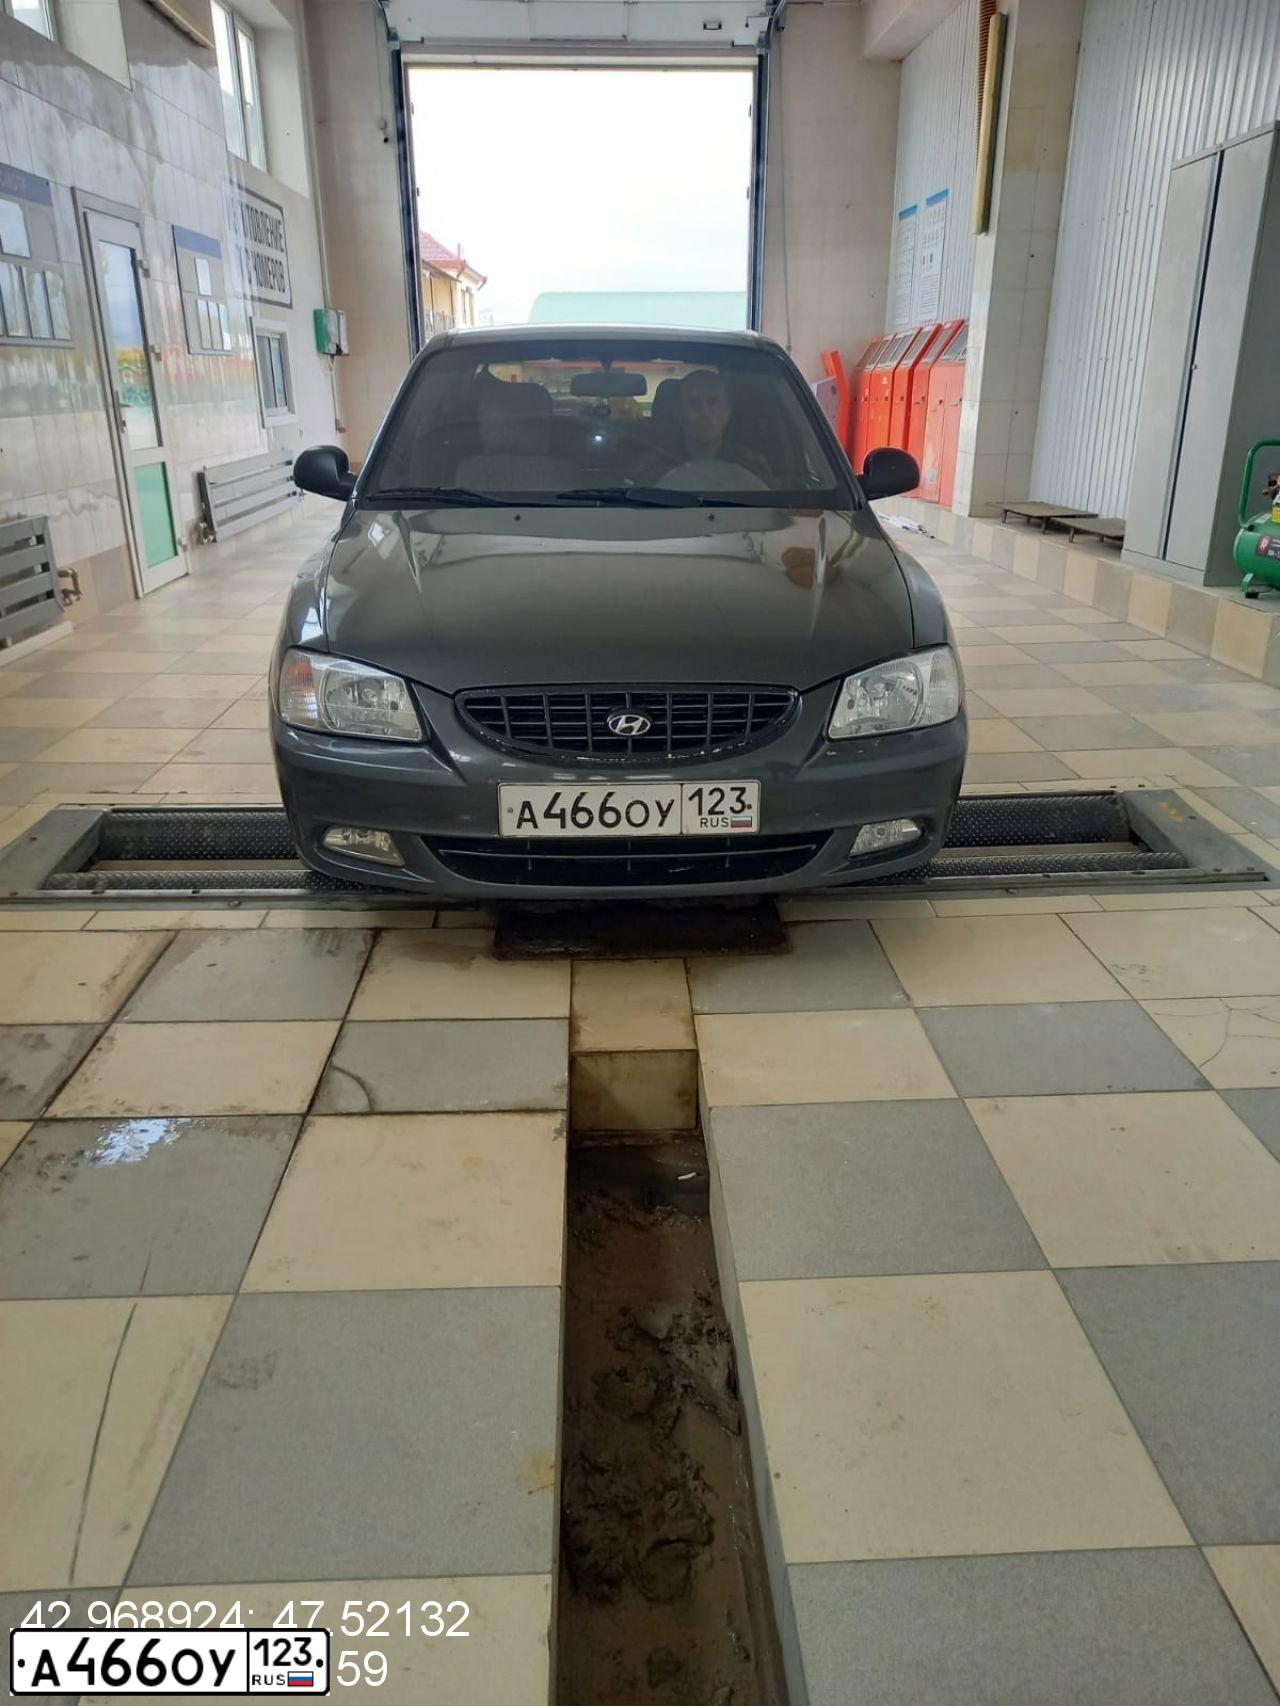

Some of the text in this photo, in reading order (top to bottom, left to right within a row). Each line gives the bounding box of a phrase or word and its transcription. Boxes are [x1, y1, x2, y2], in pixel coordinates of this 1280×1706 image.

[516, 786, 747, 830] А466ОУ 123
[700, 817, 729, 829] RUS
